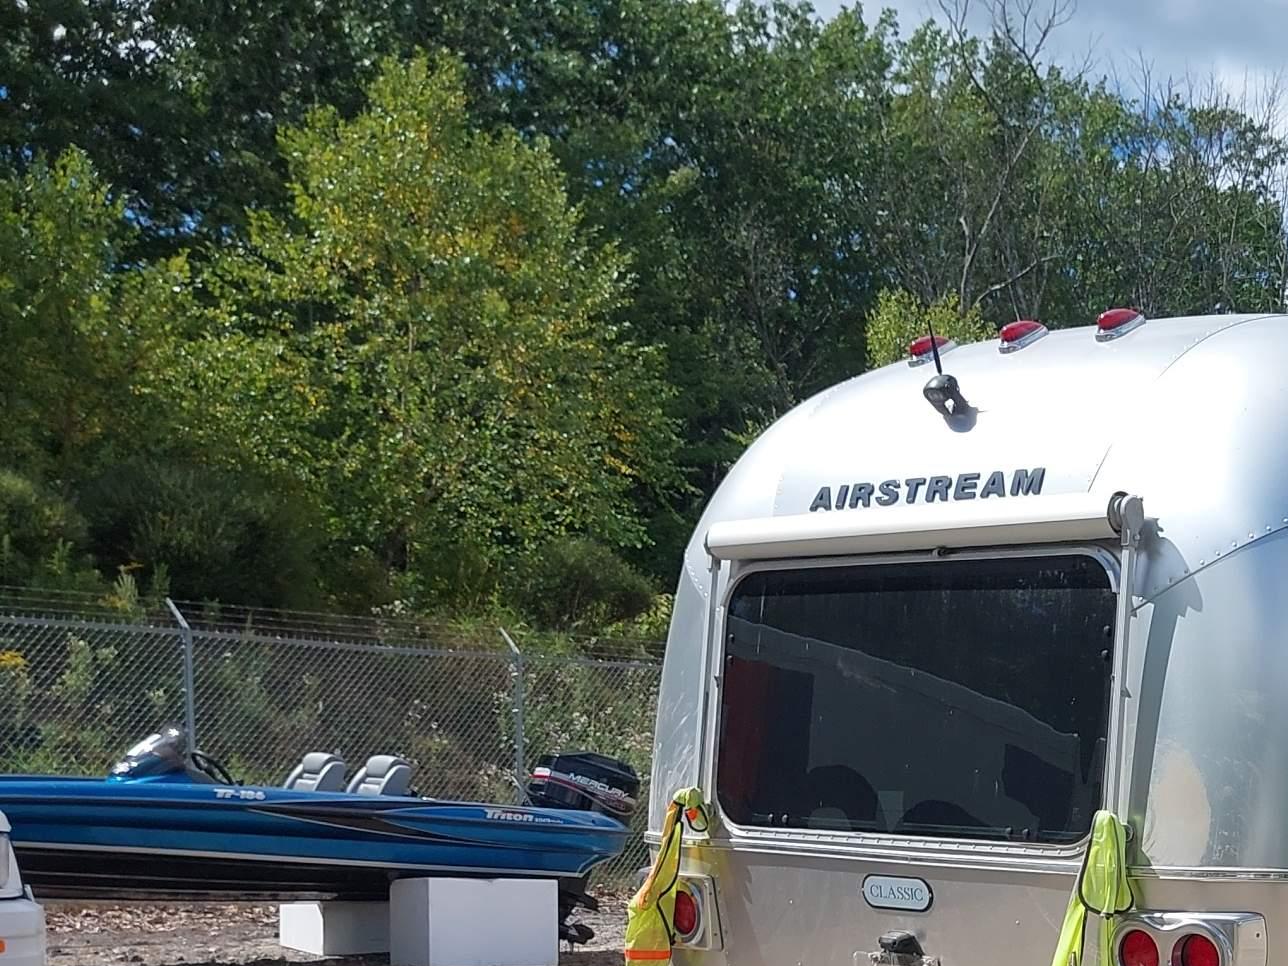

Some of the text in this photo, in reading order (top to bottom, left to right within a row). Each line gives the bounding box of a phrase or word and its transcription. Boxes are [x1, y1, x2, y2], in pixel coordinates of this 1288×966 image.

[809, 467, 1046, 512] AIRSTREAM
[568, 772, 630, 799] MERCURY
[483, 809, 534, 822] Triton
[869, 883, 924, 902] CLASSIC
